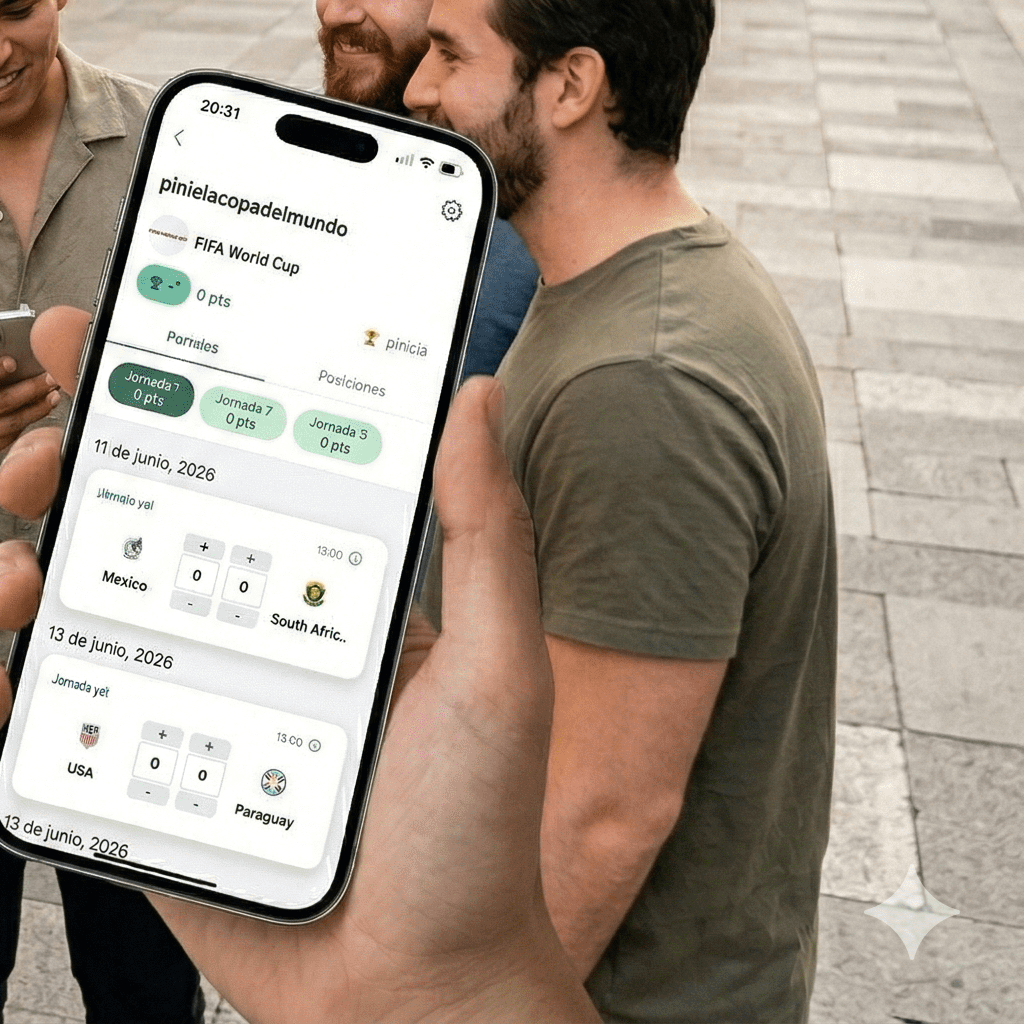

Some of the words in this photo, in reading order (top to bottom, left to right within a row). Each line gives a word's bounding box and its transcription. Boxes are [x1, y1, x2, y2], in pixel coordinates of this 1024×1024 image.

[200, 99, 241, 120] 20:31
[158, 176, 348, 237] pinielacopadelmundo
[194, 236, 224, 256] FIFA
[229, 244, 270, 267] World
[272, 256, 300, 277] Cup
[196, 288, 206, 302] 0
[208, 293, 232, 308] pts
[385, 337, 428, 357] pinicia
[143, 392, 165, 407] pts
[215, 393, 263, 414] Jornada
[225, 412, 235, 425] 0
[235, 416, 257, 430] pts
[309, 416, 356, 438] Jornada
[319, 436, 329, 449] 0
[330, 441, 351, 455] pts
[94, 439, 108, 455] 11
[111, 444, 130, 460] de
[131, 448, 173, 475] junio,
[177, 460, 217, 482] 2026
[316, 545, 344, 561] 13:00
[101, 570, 148, 593] Mexico
[192, 569, 202, 582] 0
[239, 581, 249, 594] 0
[270, 613, 308, 633] South
[48, 625, 65, 642] 13
[68, 631, 87, 648] de
[89, 636, 129, 662] junio,
[133, 647, 174, 670] 2026
[67, 761, 94, 779] USA
[150, 756, 160, 770] 0
[197, 769, 208, 782] 0
[234, 803, 295, 831] Paraguay
[4, 814, 21, 830] 13
[23, 820, 43, 836] de
[43, 824, 85, 851] junio,
[89, 836, 129, 858] 2026
